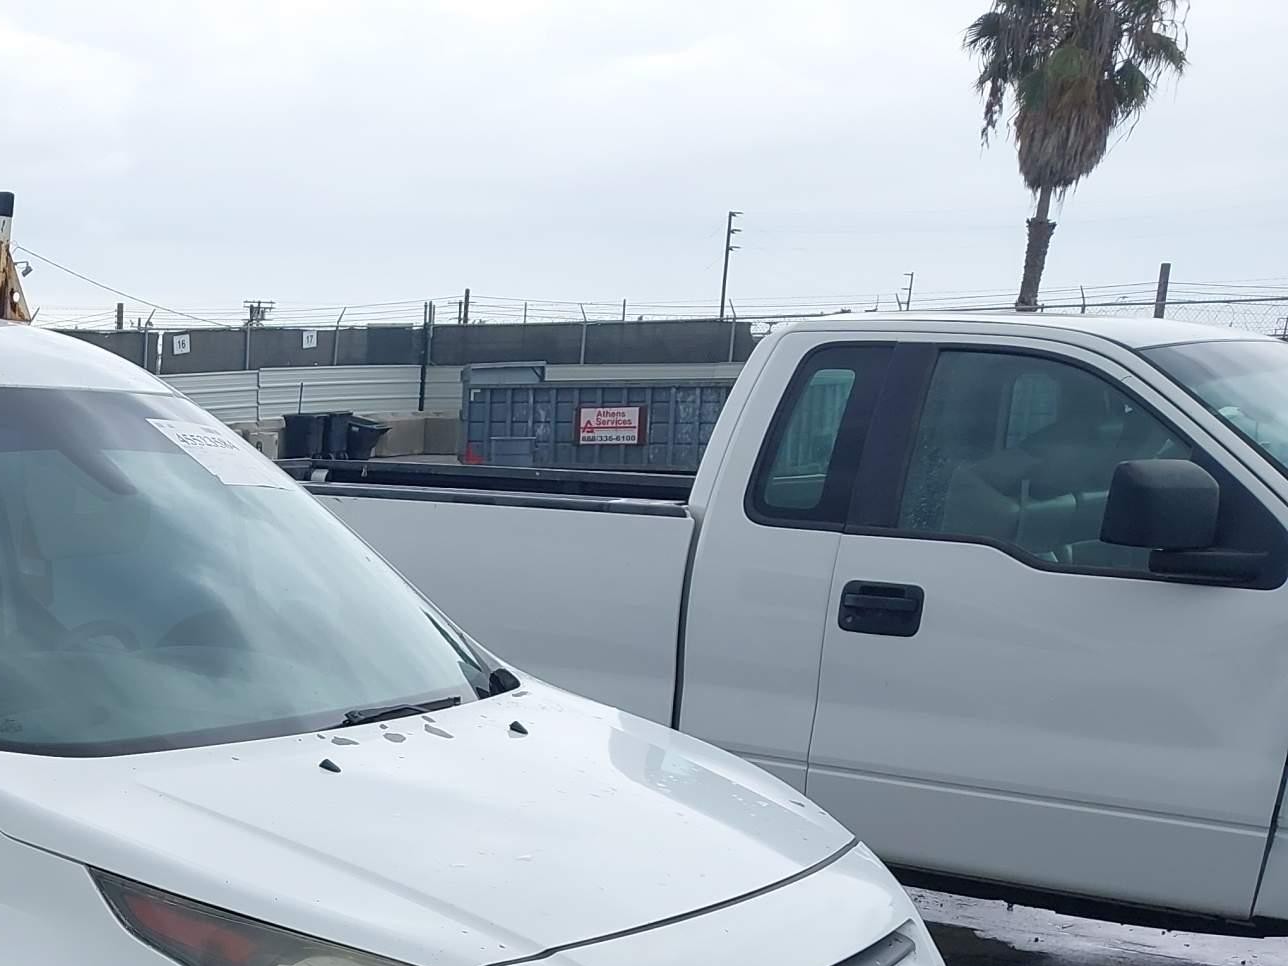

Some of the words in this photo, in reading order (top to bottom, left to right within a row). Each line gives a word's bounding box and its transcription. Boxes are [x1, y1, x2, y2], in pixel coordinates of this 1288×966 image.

[177, 339, 186, 349] 16
[306, 335, 314, 344] 17
[595, 418, 632, 426] Services
